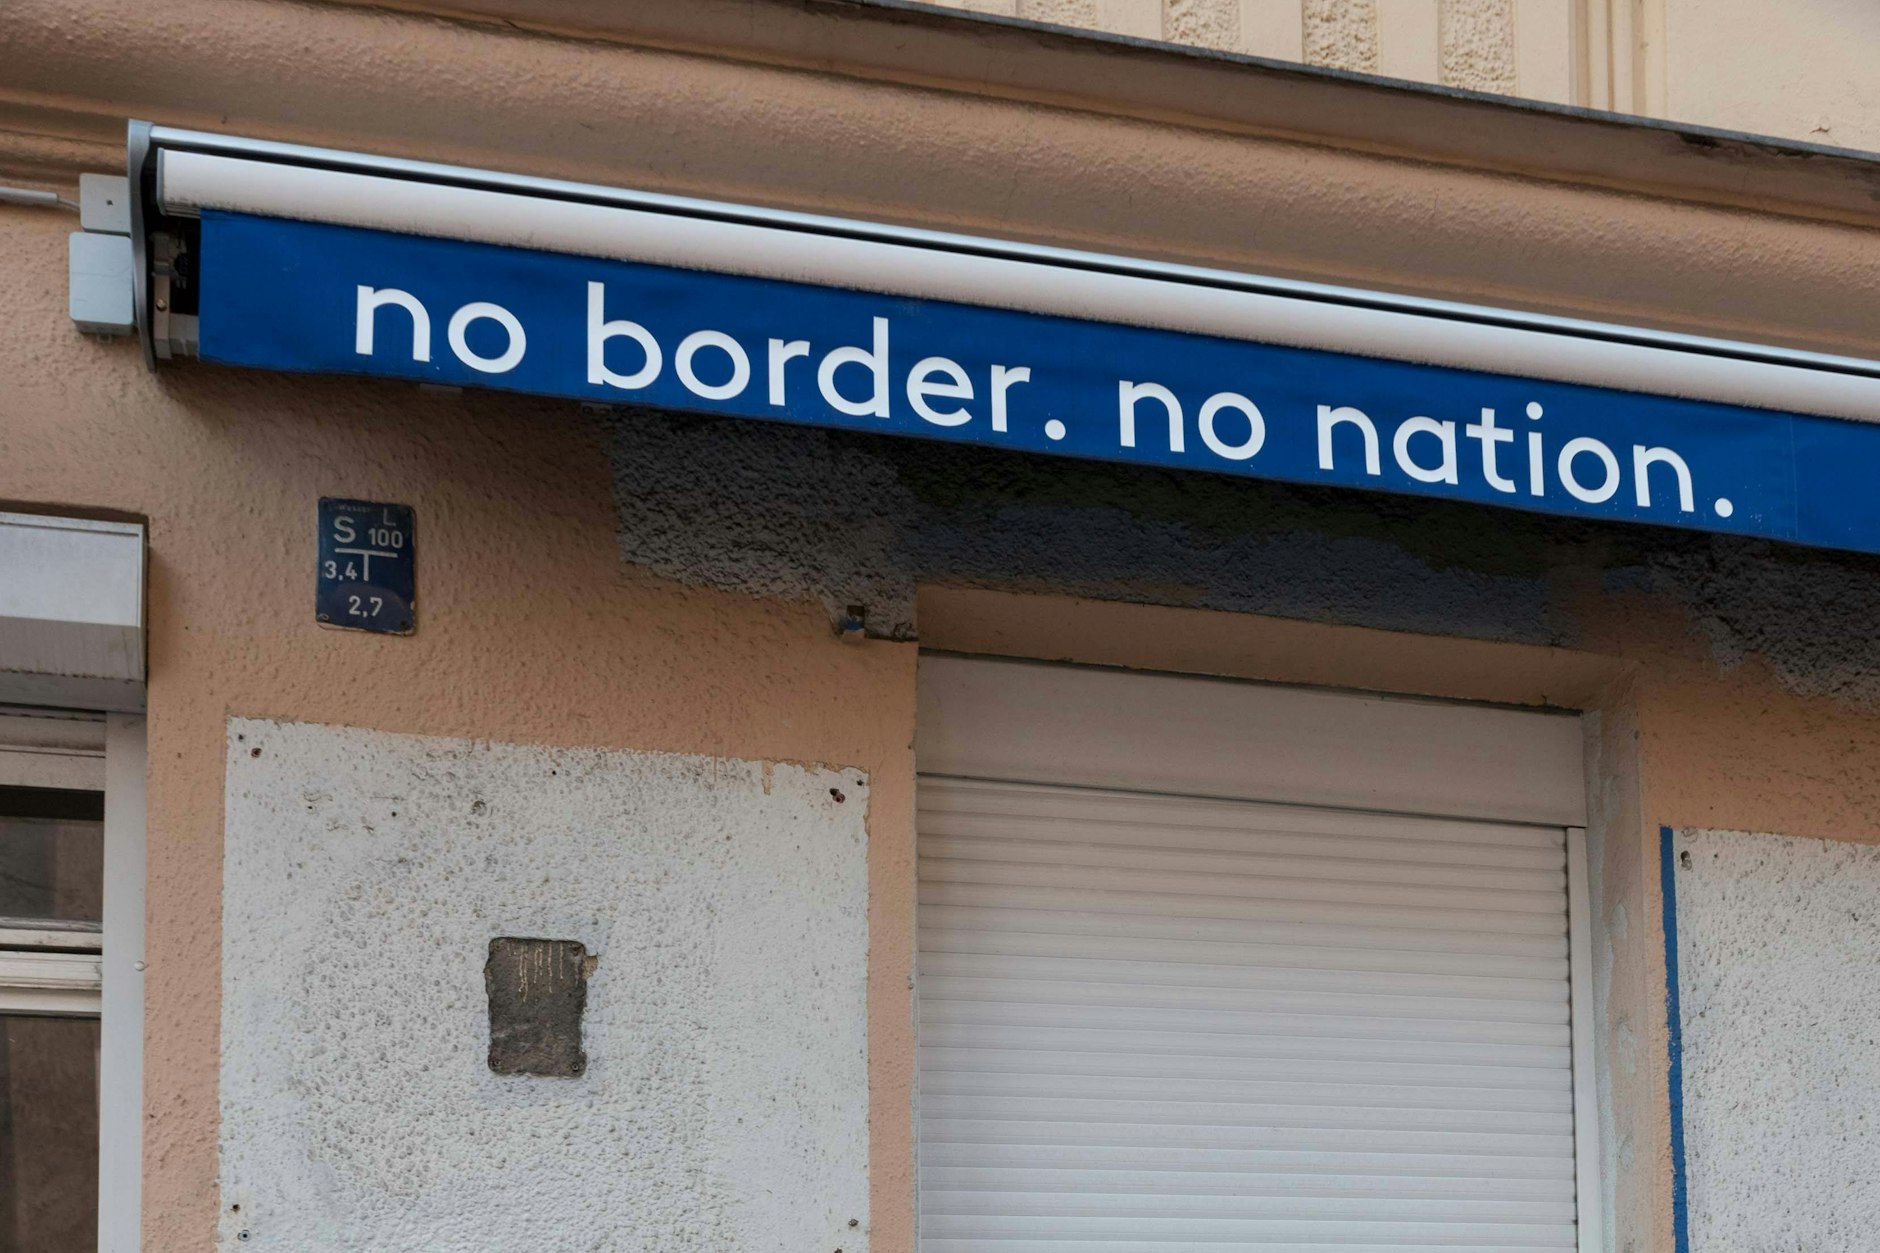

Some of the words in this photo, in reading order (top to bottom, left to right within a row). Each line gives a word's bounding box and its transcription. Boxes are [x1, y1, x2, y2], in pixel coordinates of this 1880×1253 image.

[355, 284, 528, 374] no
[587, 281, 1067, 441] border.
[1118, 380, 1267, 461] no
[1316, 401, 1734, 519] nation.
[333, 515, 356, 543] S
[383, 508, 397, 527] L
[368, 527, 404, 548] 100
